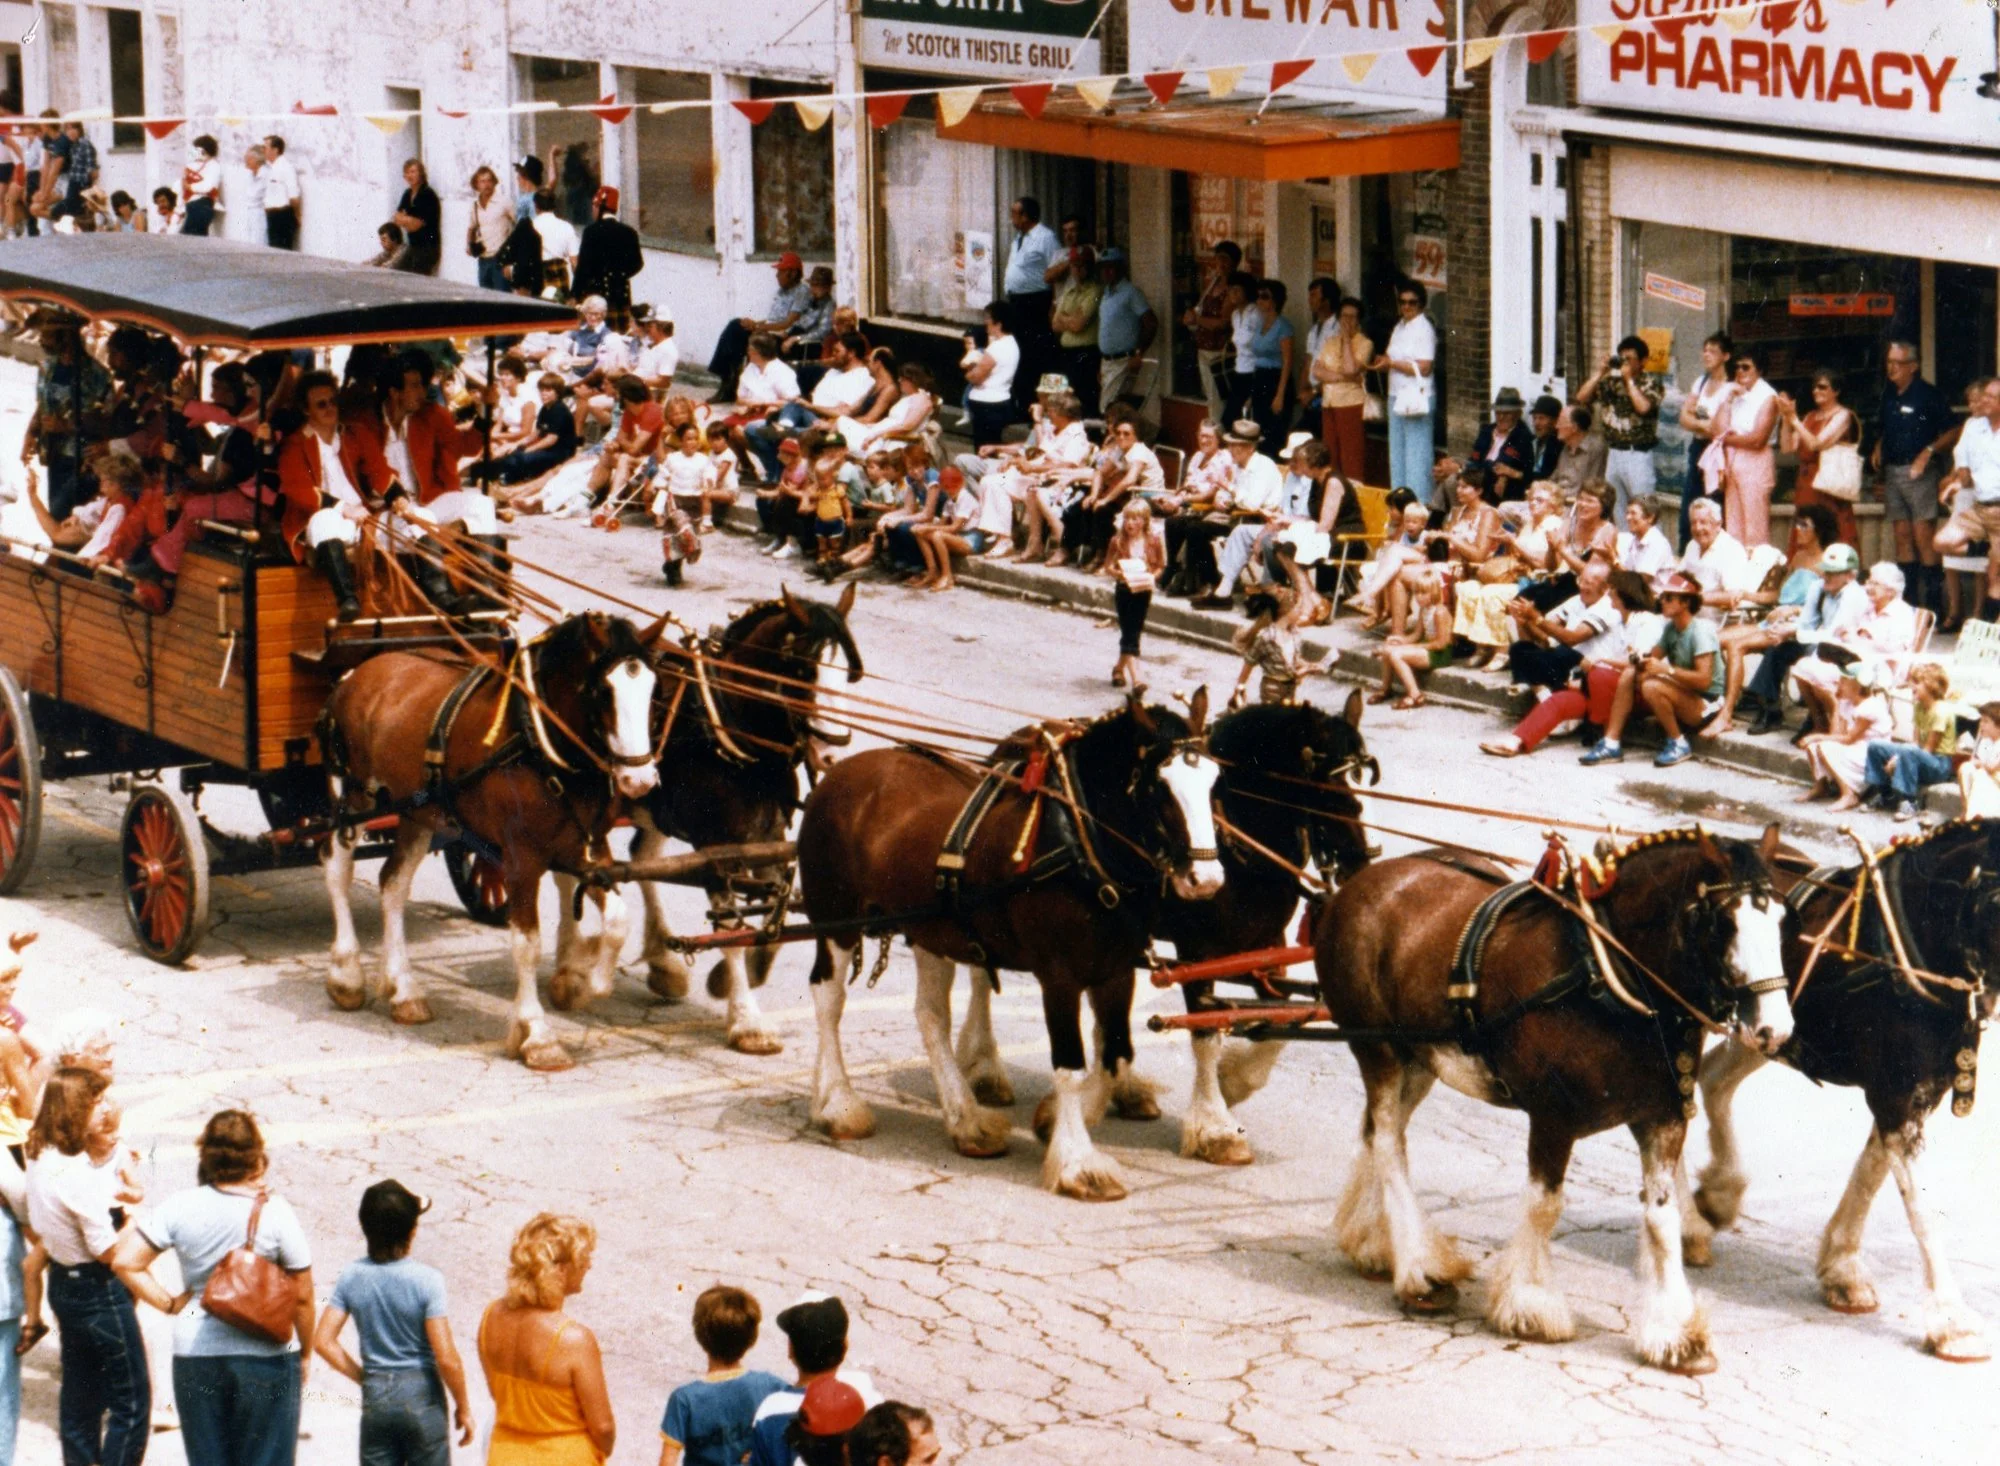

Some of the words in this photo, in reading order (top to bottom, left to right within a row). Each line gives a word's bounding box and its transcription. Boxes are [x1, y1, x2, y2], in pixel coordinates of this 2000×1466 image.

[907, 32, 960, 58] SCOTCH
[965, 38, 1023, 65] THISTLE
[1028, 43, 1074, 70] GRILL
[1610, 30, 1958, 113] PHARMACY
